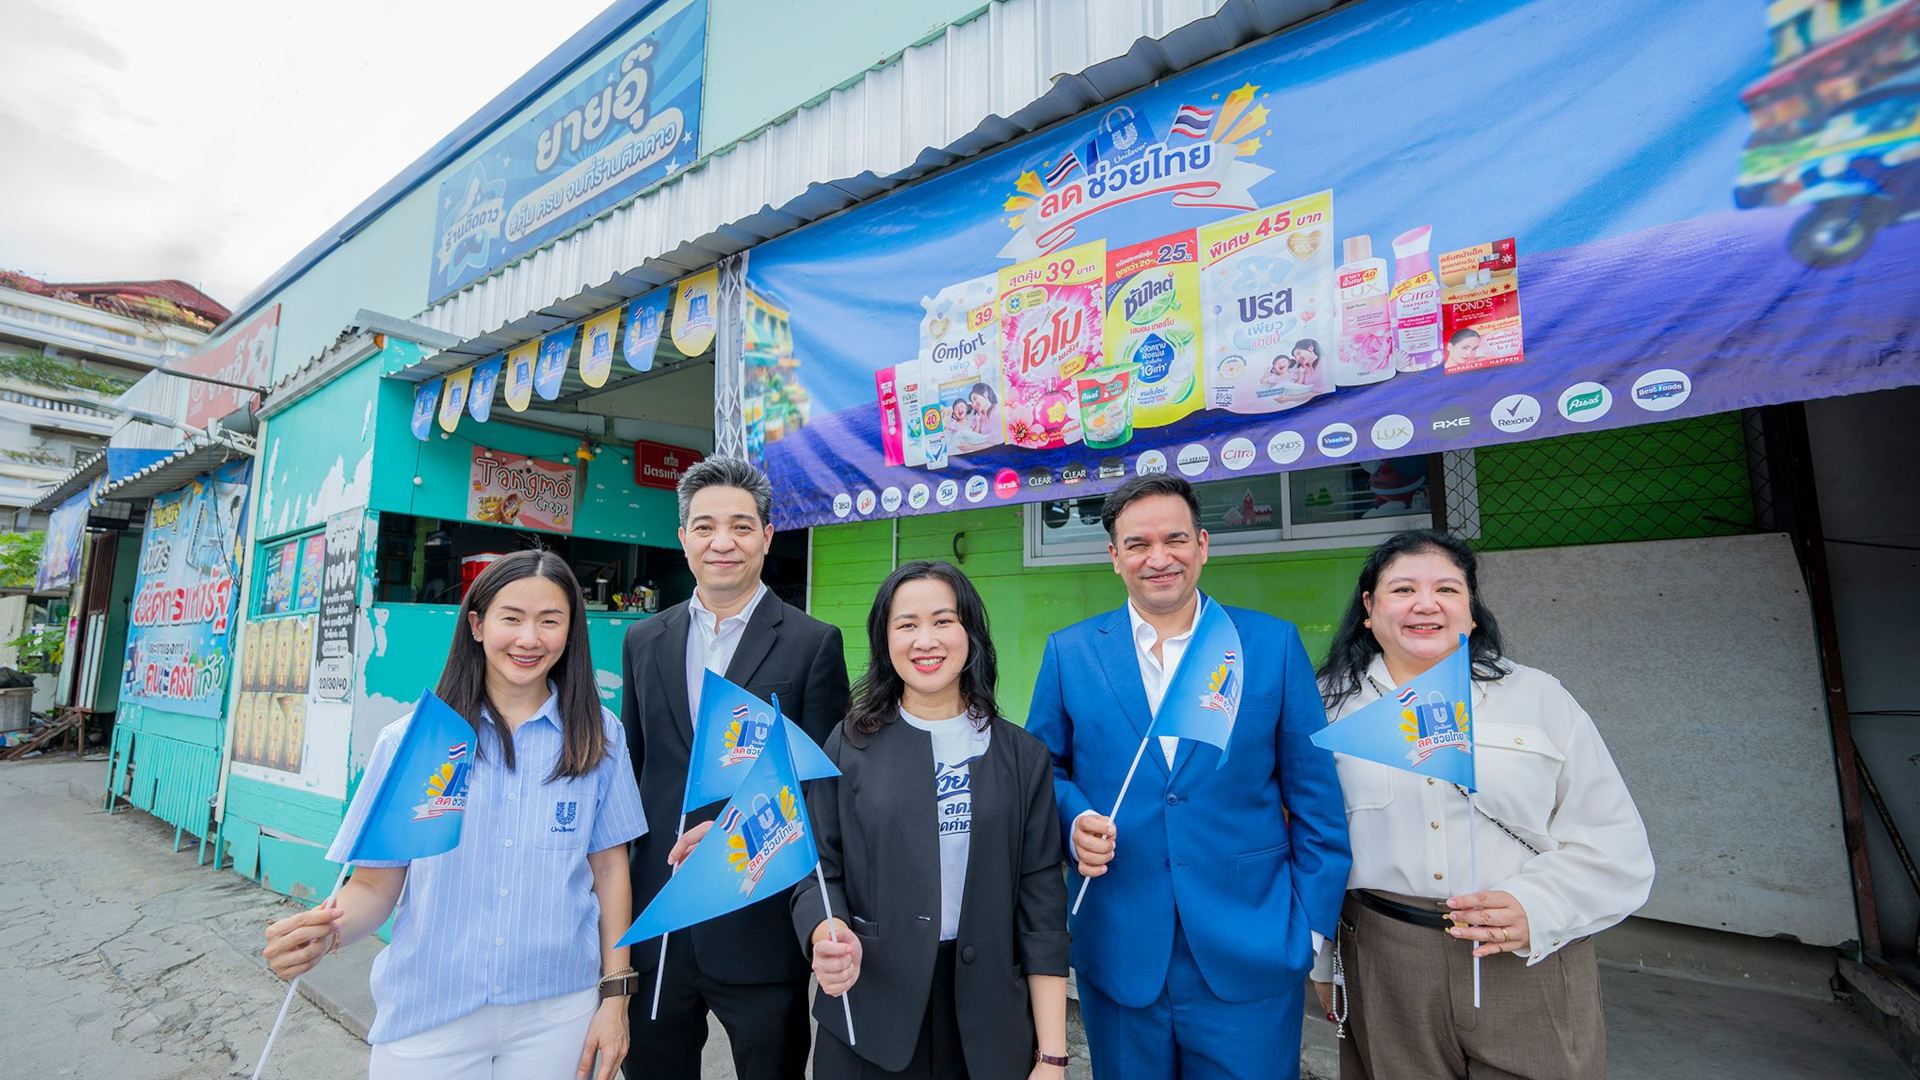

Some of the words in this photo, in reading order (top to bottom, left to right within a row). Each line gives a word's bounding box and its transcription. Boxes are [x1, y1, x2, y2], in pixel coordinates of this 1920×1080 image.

[535, 42, 653, 172] ยายอุ๊
[1113, 142, 1147, 165] Unilever
[1040, 184, 1083, 218] ลด
[1087, 143, 1211, 199] ช่วยไทย
[536, 186, 564, 220] ครบ
[1209, 232, 1250, 259] พิเศษ
[1255, 210, 1291, 237] 45
[1296, 212, 1322, 227] บาท
[1157, 243, 1187, 265] 25
[1009, 269, 1042, 287] สุดคุ้ม
[1045, 258, 1076, 283] 39
[1076, 264, 1096, 275] บาท
[1115, 261, 1139, 279] ถูกกว่า
[1414, 274, 1428, 285] 49
[1399, 288, 1434, 304] Citra
[1238, 287, 1293, 324] บรีส
[1452, 298, 1493, 313] POND'S
[975, 307, 993, 326] 39
[1247, 320, 1284, 337] เพียว
[932, 332, 987, 363] Comfort
[1021, 306, 1083, 375] โอโม
[1489, 356, 1520, 365] HAPPEN
[1638, 385, 1658, 397] Best
[1658, 382, 1682, 392] Foods
[1568, 393, 1601, 412] คนอร์
[926, 414, 938, 426] 40
[1432, 416, 1471, 431] AXE
[1498, 415, 1534, 428] Rexona
[1324, 435, 1351, 445] Vaseline
[1376, 426, 1410, 441] LUX
[1270, 440, 1301, 451] POND'S
[1223, 449, 1254, 461] Citra
[1062, 469, 1087, 480] CLEAR
[1140, 464, 1164, 475] Dove
[475, 457, 571, 502] Tangmo
[997, 480, 1018, 490] sunsilk
[1028, 476, 1052, 487] CLEAR
[535, 496, 569, 517] Crepe
[1417, 736, 1433, 748] ลด
[1432, 730, 1465, 744] ช่วยไทย
[732, 747, 746, 755] ลด
[434, 796, 452, 806] ลด
[748, 853, 765, 872] ลด
[763, 822, 795, 855] ช่วยไทย
